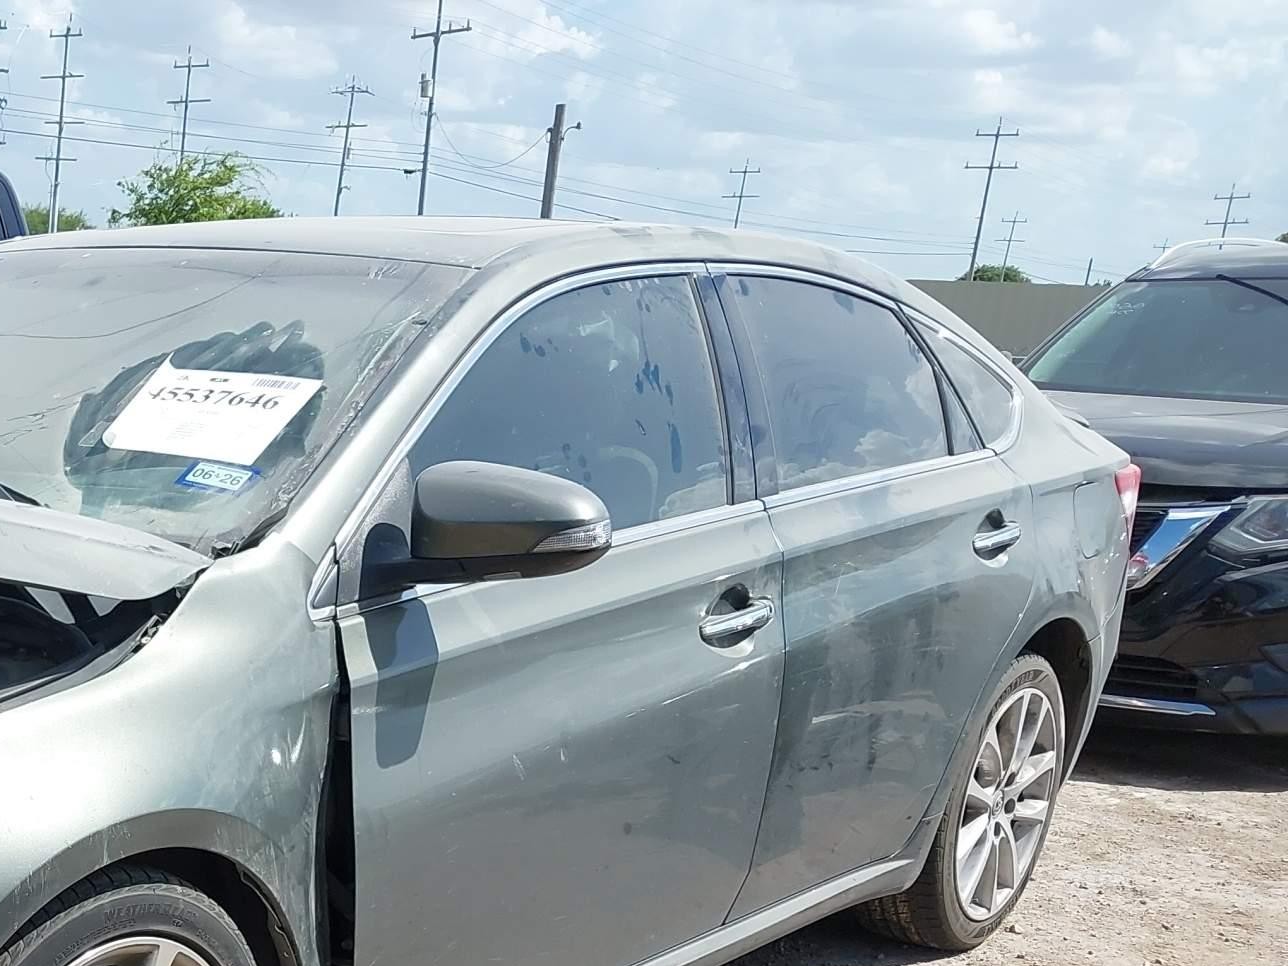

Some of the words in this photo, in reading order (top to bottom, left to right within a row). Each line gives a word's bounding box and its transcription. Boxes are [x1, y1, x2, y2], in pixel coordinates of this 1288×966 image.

[148, 386, 284, 410] 45537646
[192, 468, 215, 480] 06
[219, 473, 243, 486] 26
